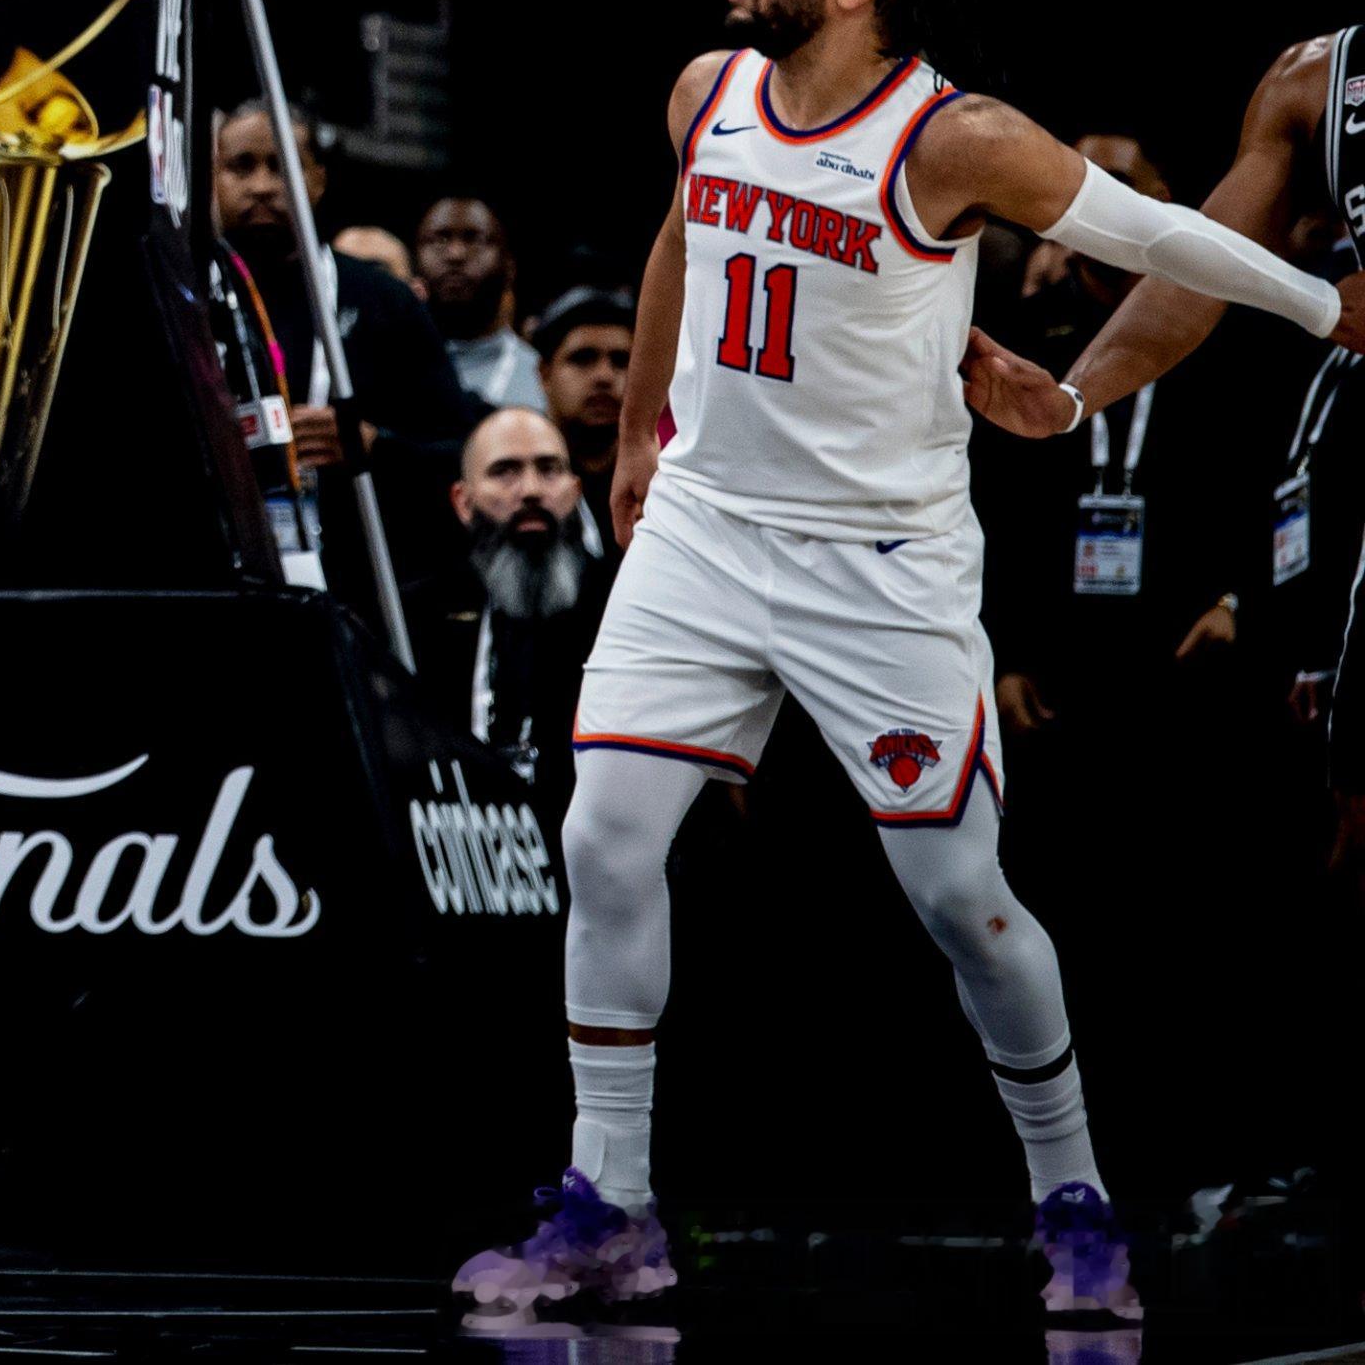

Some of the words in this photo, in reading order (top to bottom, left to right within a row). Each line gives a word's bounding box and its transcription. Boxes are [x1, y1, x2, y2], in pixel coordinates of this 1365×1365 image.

[687, 173, 763, 235] NEW
[766, 187, 883, 276] YORK
[816, 156, 839, 171] abu
[841, 164, 875, 181] dhabi
[717, 252, 798, 383] 11
[408, 758, 560, 916] coinbase
